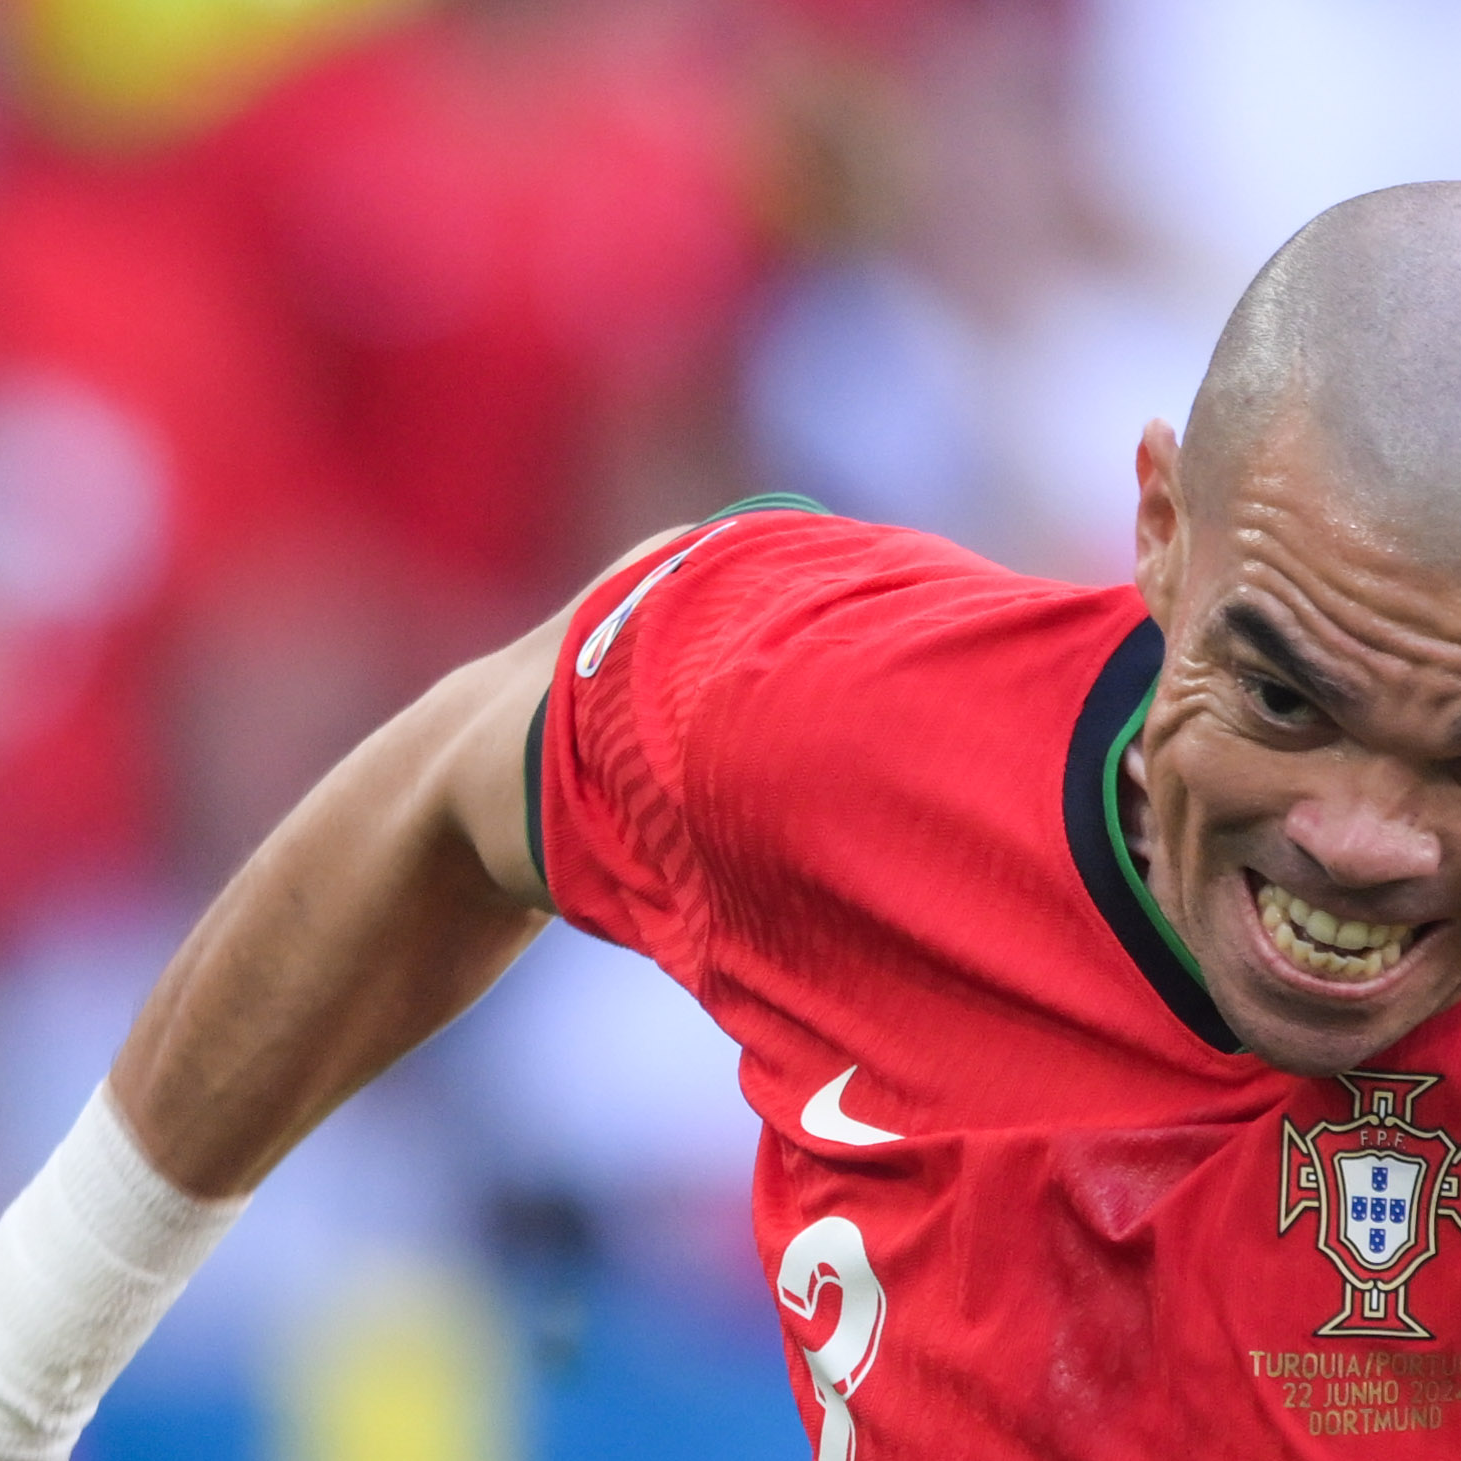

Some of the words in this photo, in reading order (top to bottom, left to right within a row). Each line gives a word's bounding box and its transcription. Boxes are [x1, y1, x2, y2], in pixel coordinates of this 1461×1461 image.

[1282, 1382, 1313, 1408] 22
[1323, 1380, 1399, 1407] JUNHO
[1308, 1406, 1443, 1437] DORTMUND
